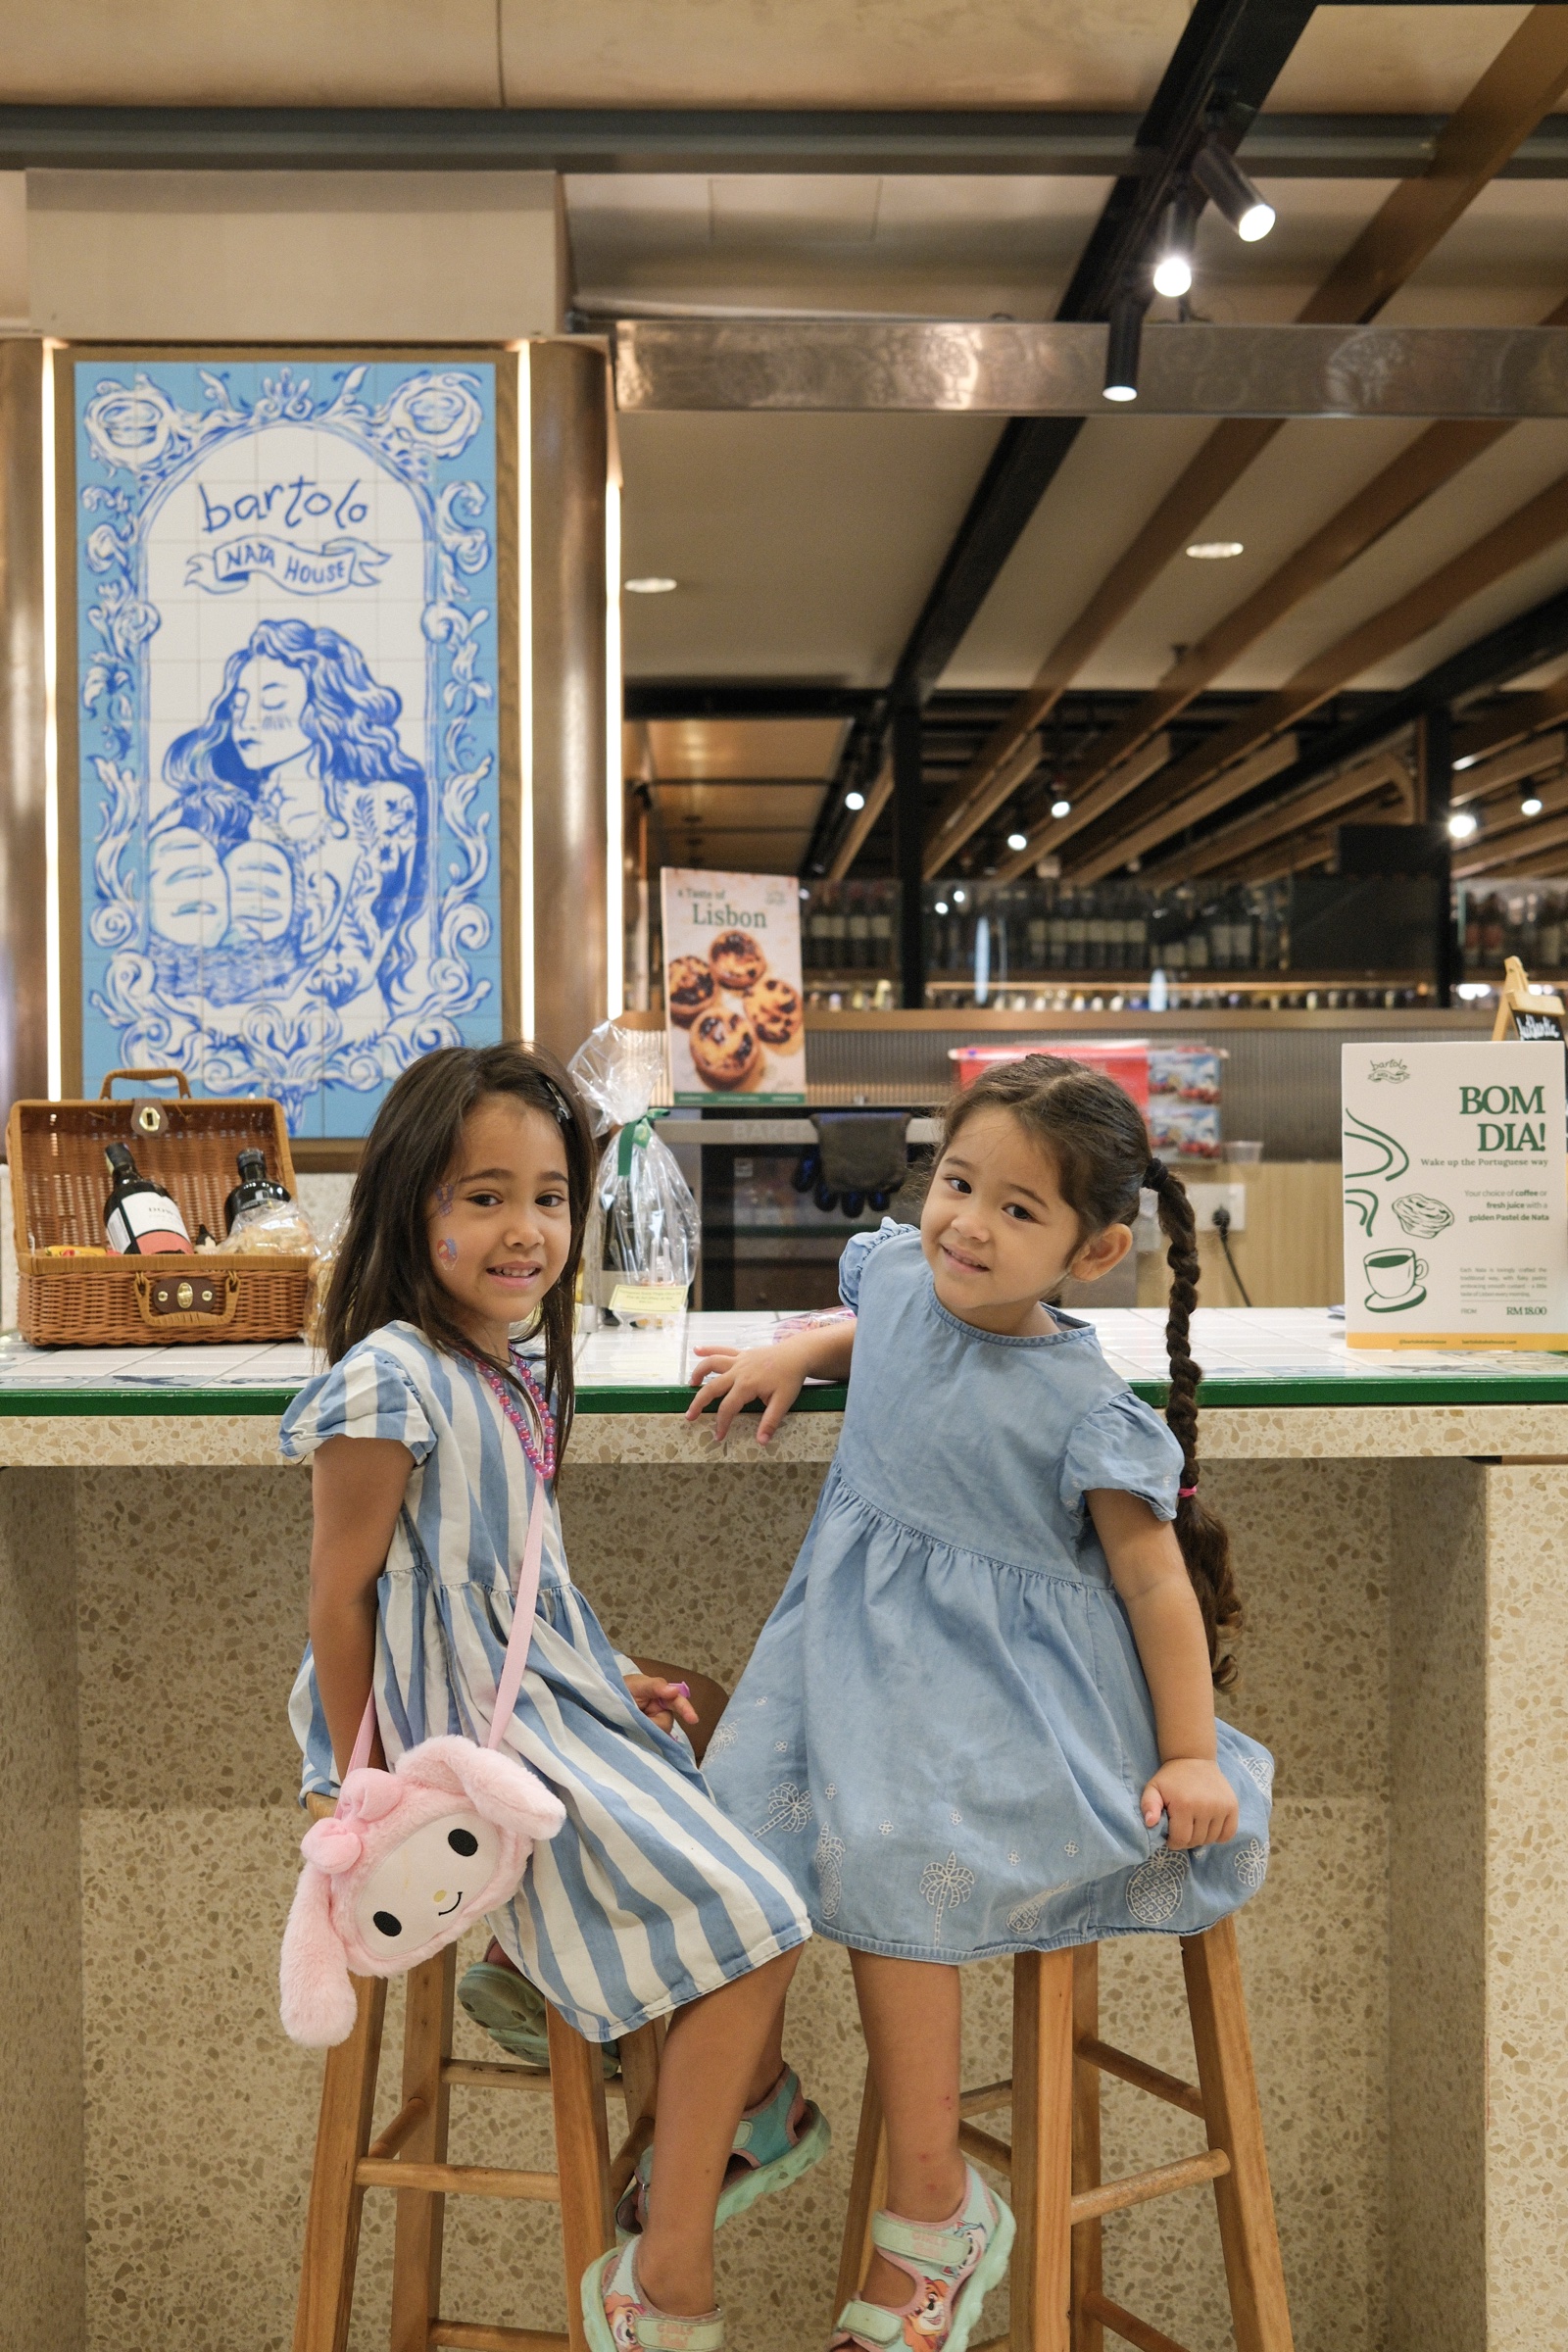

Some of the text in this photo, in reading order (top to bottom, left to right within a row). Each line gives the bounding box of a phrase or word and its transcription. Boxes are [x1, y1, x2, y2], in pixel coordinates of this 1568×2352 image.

[199, 474, 368, 534] bartolo
[225, 543, 346, 584] NATA HOUSE
[692, 902, 768, 929] Lisbon
[1458, 1085, 1546, 1115] BOM
[1476, 1122, 1546, 1152] DIA!
[1447, 1159, 1459, 1168] up
[1461, 1157, 1476, 1166] the
[1478, 1157, 1529, 1168] Portuguese
[1531, 1158, 1548, 1168] way
[1469, 1214, 1494, 1223] golden
[1506, 1201, 1525, 1210] juice
[1506, 1306, 1523, 1315] RM
[1524, 1306, 1547, 1315] 18.00
